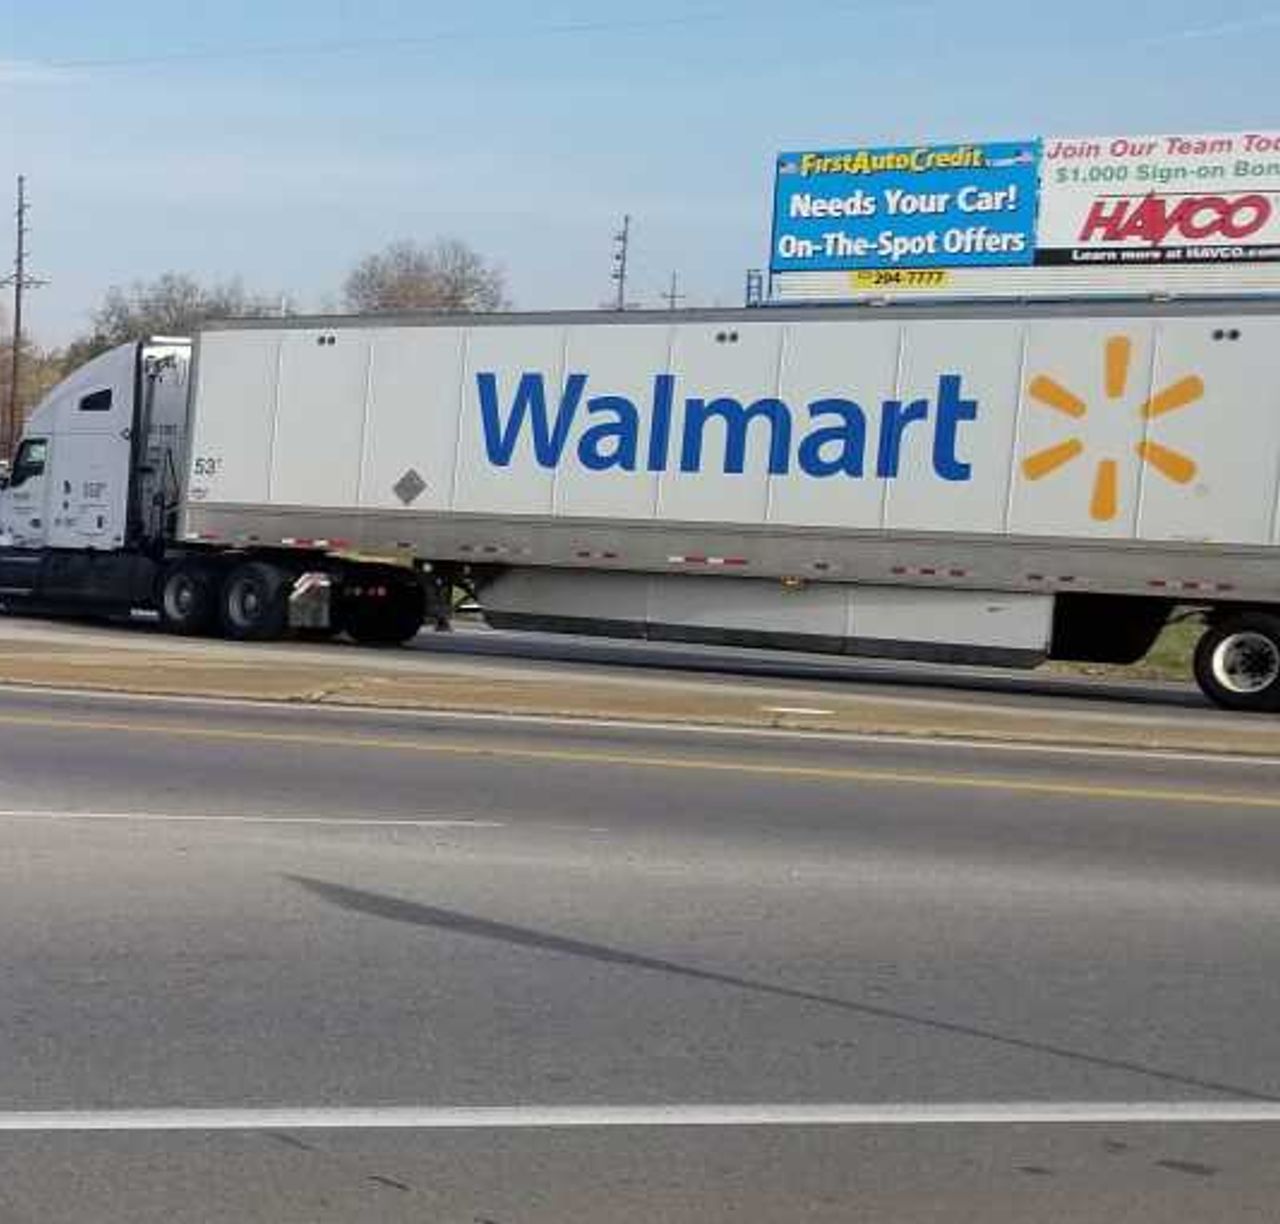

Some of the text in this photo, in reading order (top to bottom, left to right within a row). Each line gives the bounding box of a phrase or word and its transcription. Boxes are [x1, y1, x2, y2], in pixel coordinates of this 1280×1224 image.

[801, 146, 985, 176] FirstAutoCredit
[1047, 141, 1100, 159] Join
[1109, 139, 1157, 157] Our
[1165, 137, 1233, 155] Team
[1135, 163, 1224, 183] Sign-on
[790, 185, 1017, 218] Needs Your Car!
[1079, 193, 1272, 243] HAVCO
[778, 227, 1025, 261] On-The-Spot Offers
[1071, 249, 1116, 261] Learn
[1121, 250, 1161, 260] more
[1166, 249, 1182, 259] at
[476, 373, 977, 481] Walmart
